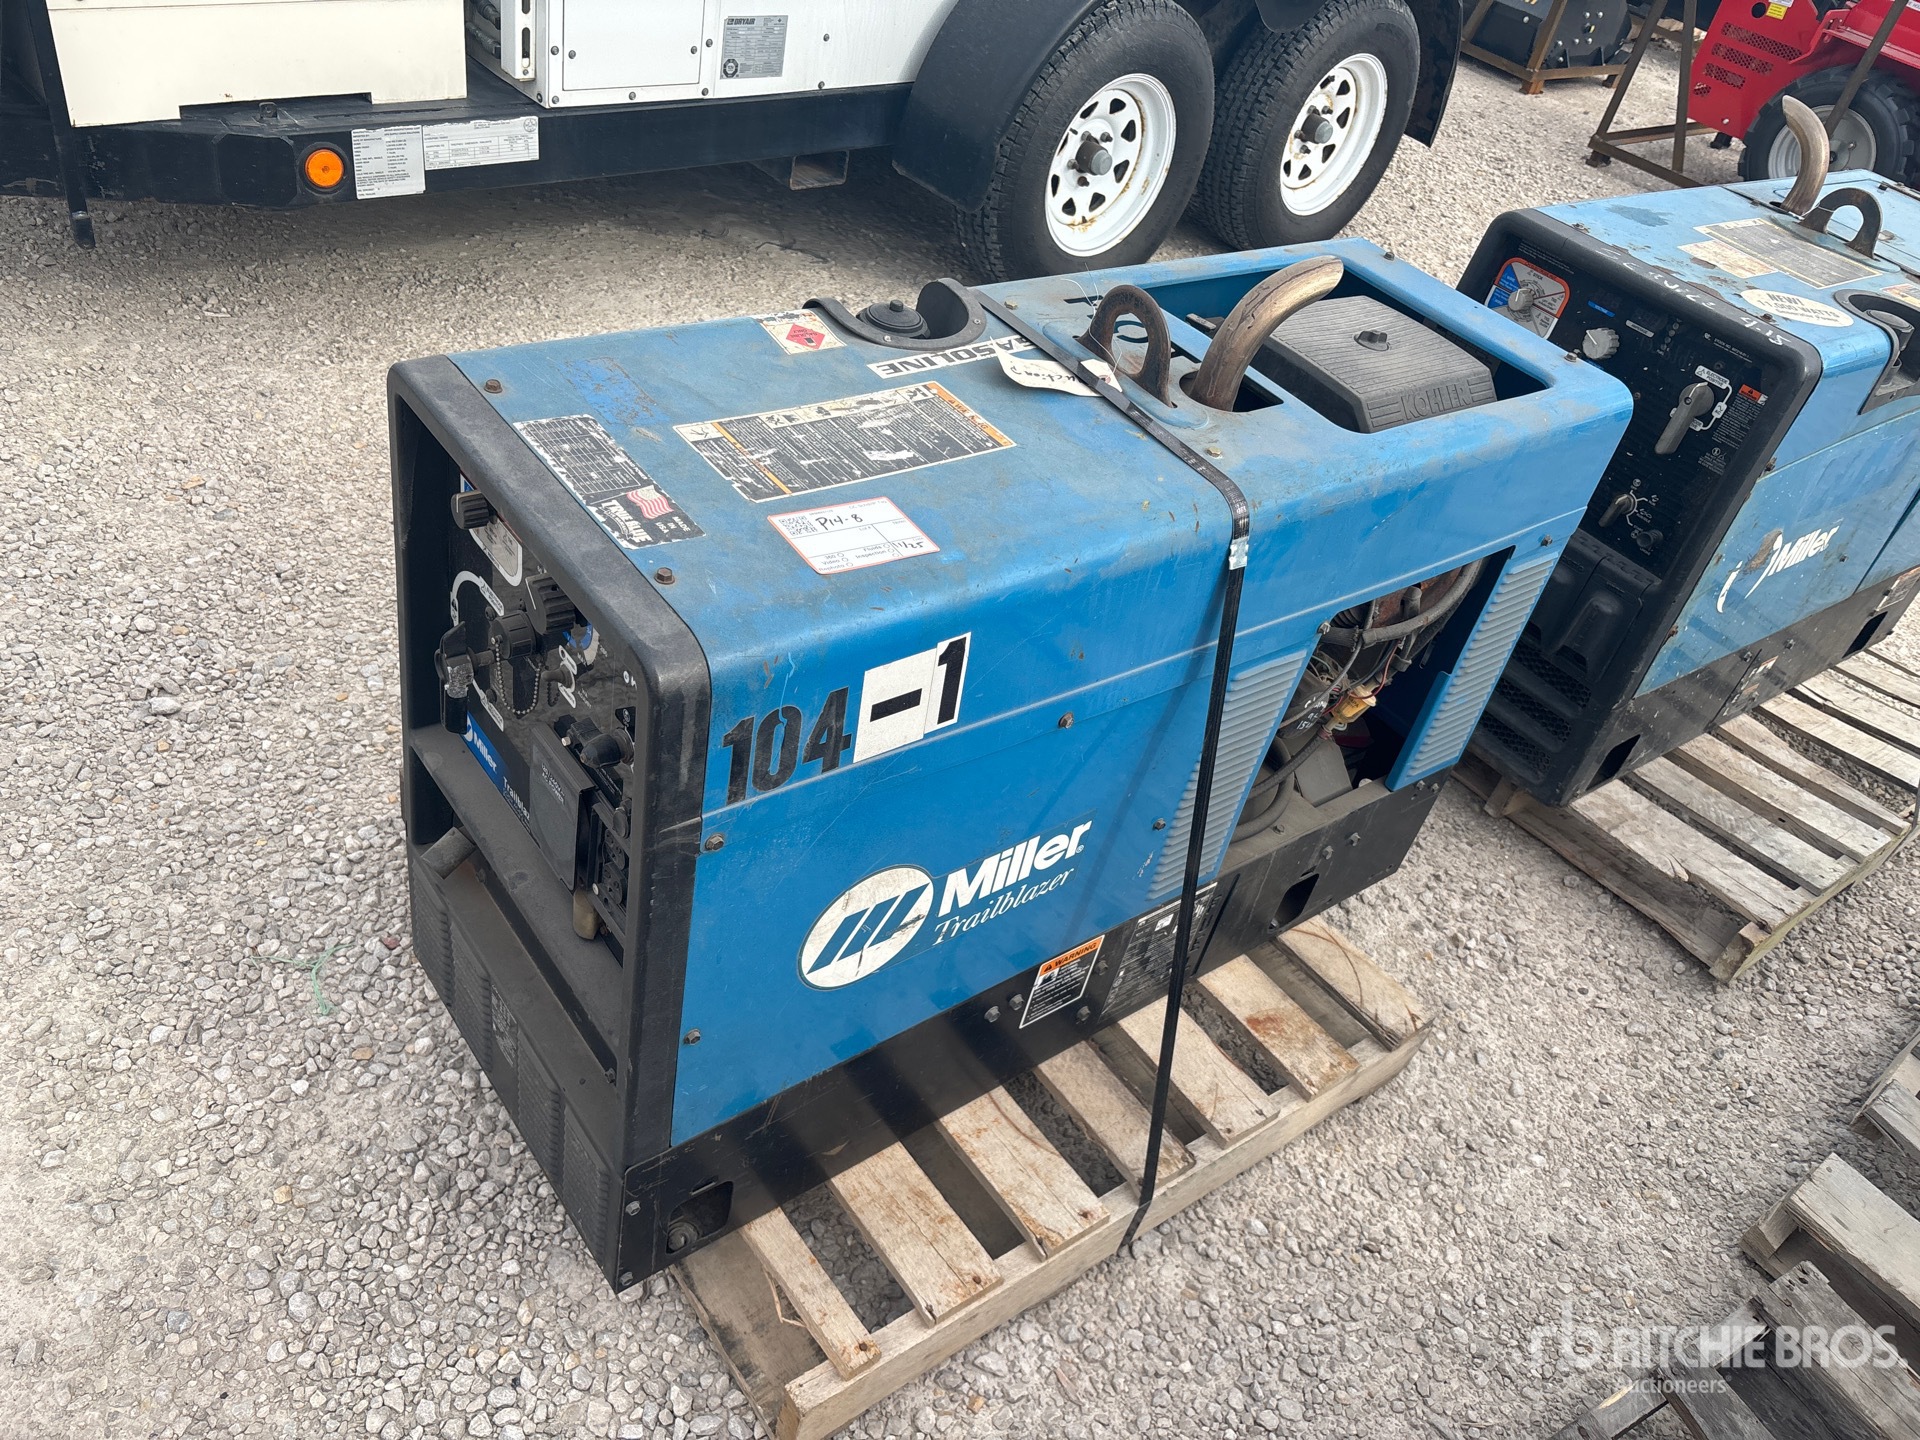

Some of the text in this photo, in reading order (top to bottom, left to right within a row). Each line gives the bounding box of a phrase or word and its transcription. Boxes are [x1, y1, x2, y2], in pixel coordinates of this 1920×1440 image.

[1594, 248, 1716, 311] SERVICE
[1759, 300, 1840, 318] 11,000 WATTS
[1766, 293, 1801, 306] NEW!
[1400, 384, 1470, 422] KOHLER
[601, 500, 632, 526] TRUE
[626, 515, 654, 544] BLUE
[655, 522, 668, 534] USA
[672, 516, 690, 532] MADE
[815, 514, 863, 531] P14-8
[855, 550, 887, 558] Inspection
[1768, 525, 1839, 576] Miller
[472, 735, 497, 772] Miller
[938, 820, 1092, 917] Miller
[934, 866, 1075, 949] Trailblazer
[1054, 942, 1097, 968] WARNING
